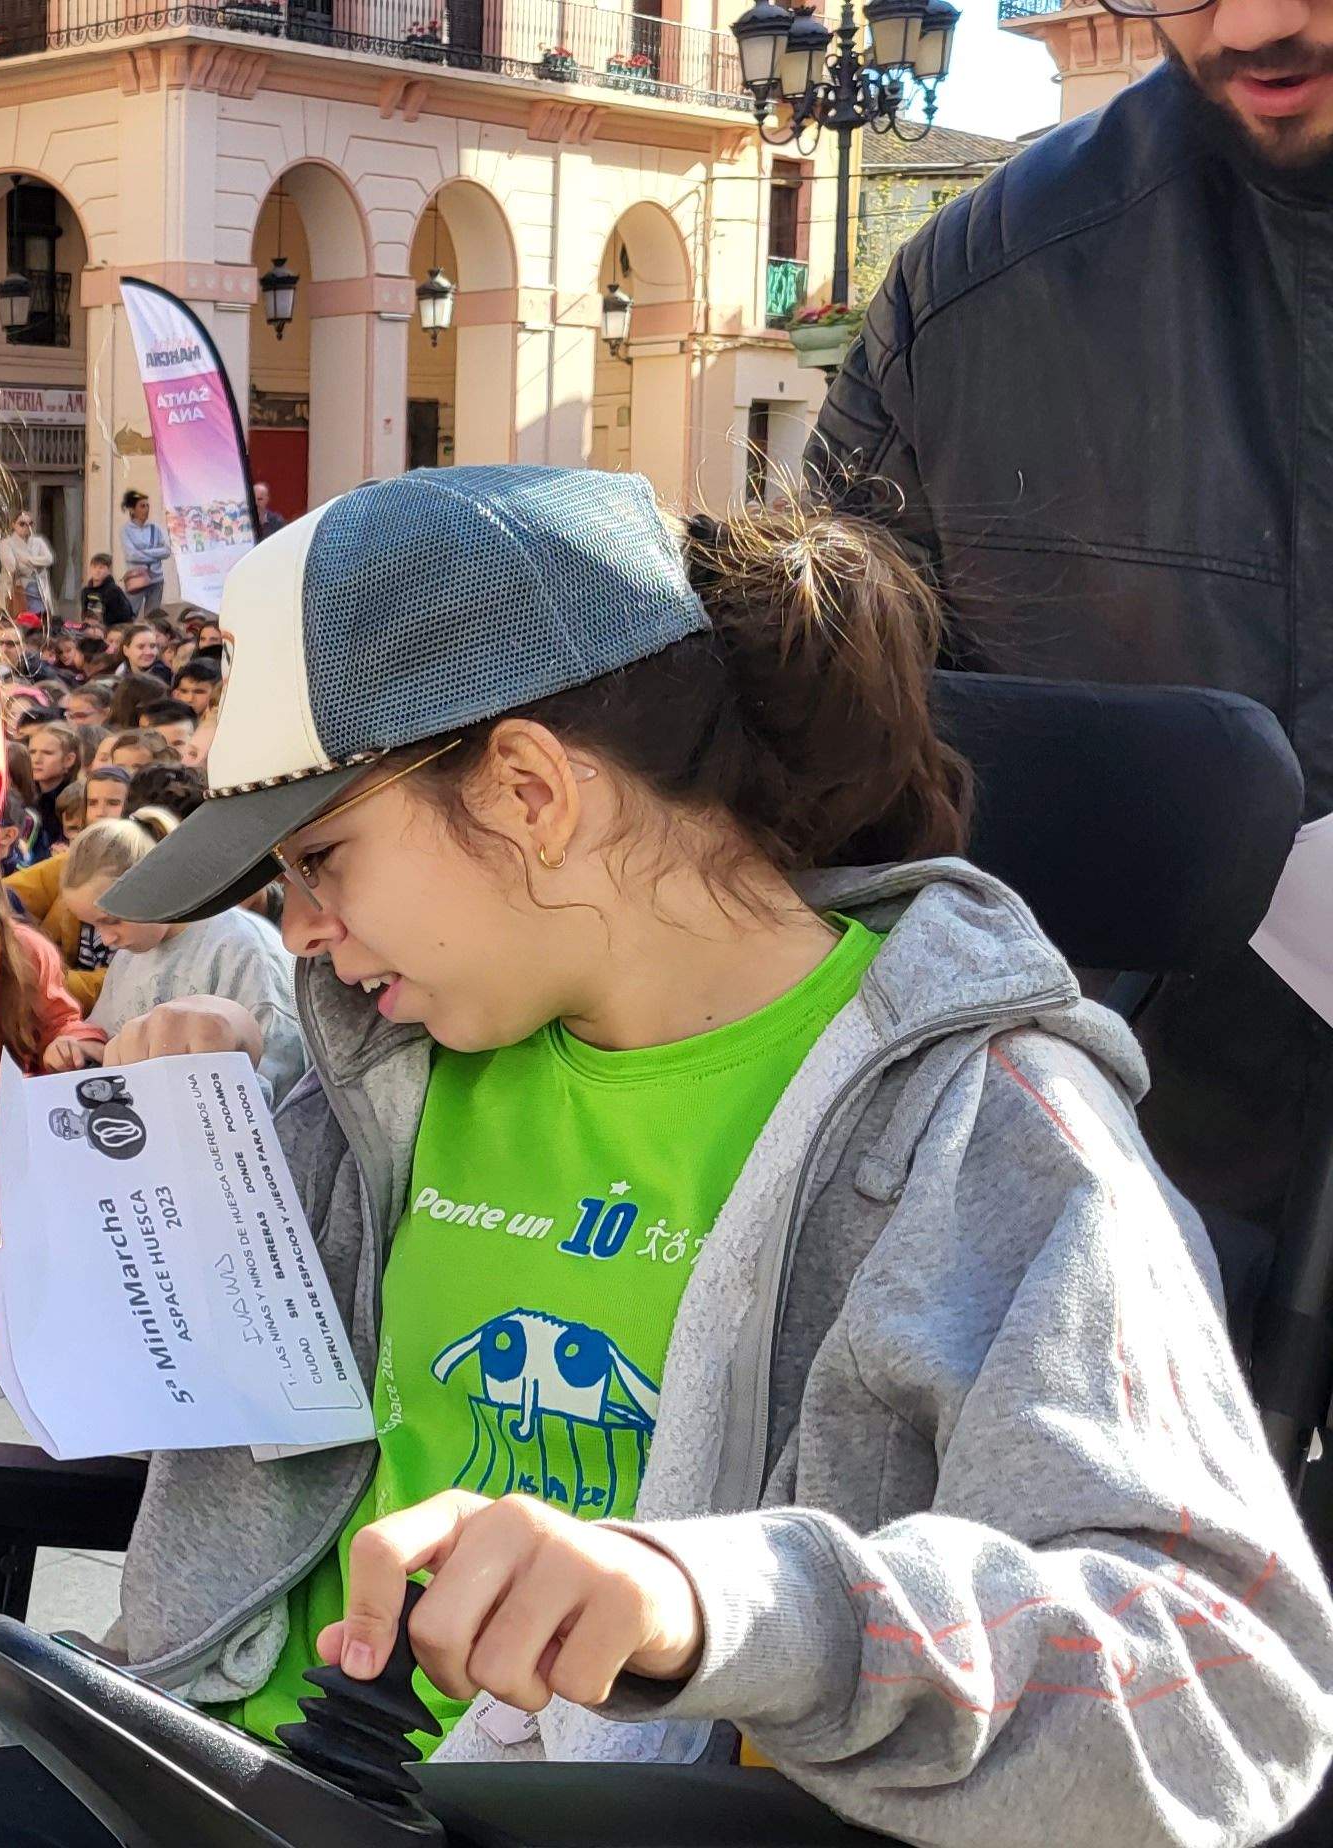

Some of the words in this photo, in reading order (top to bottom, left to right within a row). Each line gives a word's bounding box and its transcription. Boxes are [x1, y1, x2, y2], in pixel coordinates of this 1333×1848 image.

[187, 1073, 202, 1099] UNA
[210, 1072, 237, 1133] PODAMOS
[196, 1101, 224, 1171] QUEREMOS
[251, 1128, 268, 1162] PARA
[234, 1151, 256, 1193] DONDE
[261, 1164, 287, 1213] JUEGOS
[155, 1185, 183, 1229] 2023
[219, 1174, 247, 1224] HUESCA
[281, 1216, 290, 1224] Y
[129, 1189, 166, 1265] HUESCA
[236, 1228, 250, 1246] DE
[412, 1186, 506, 1231] Ponte
[505, 1212, 554, 1240] un
[556, 1196, 640, 1260] 10
[256, 1211, 286, 1280] BARRERAS
[285, 1226, 313, 1288] ESPACIOS
[98, 1198, 176, 1370] MiniMarcha
[243, 1250, 263, 1288] NIÑOS
[154, 1270, 192, 1342] ASPACE
[256, 1292, 267, 1301] Y
[283, 1298, 299, 1319] SIN
[307, 1291, 321, 1309] DE
[260, 1304, 281, 1342] NIÑAS
[275, 1346, 292, 1369] LAS
[298, 1337, 323, 1385] CIUDAD
[314, 1310, 348, 1382] DISFRUTAR
[164, 1379, 195, 1404] 5ª
